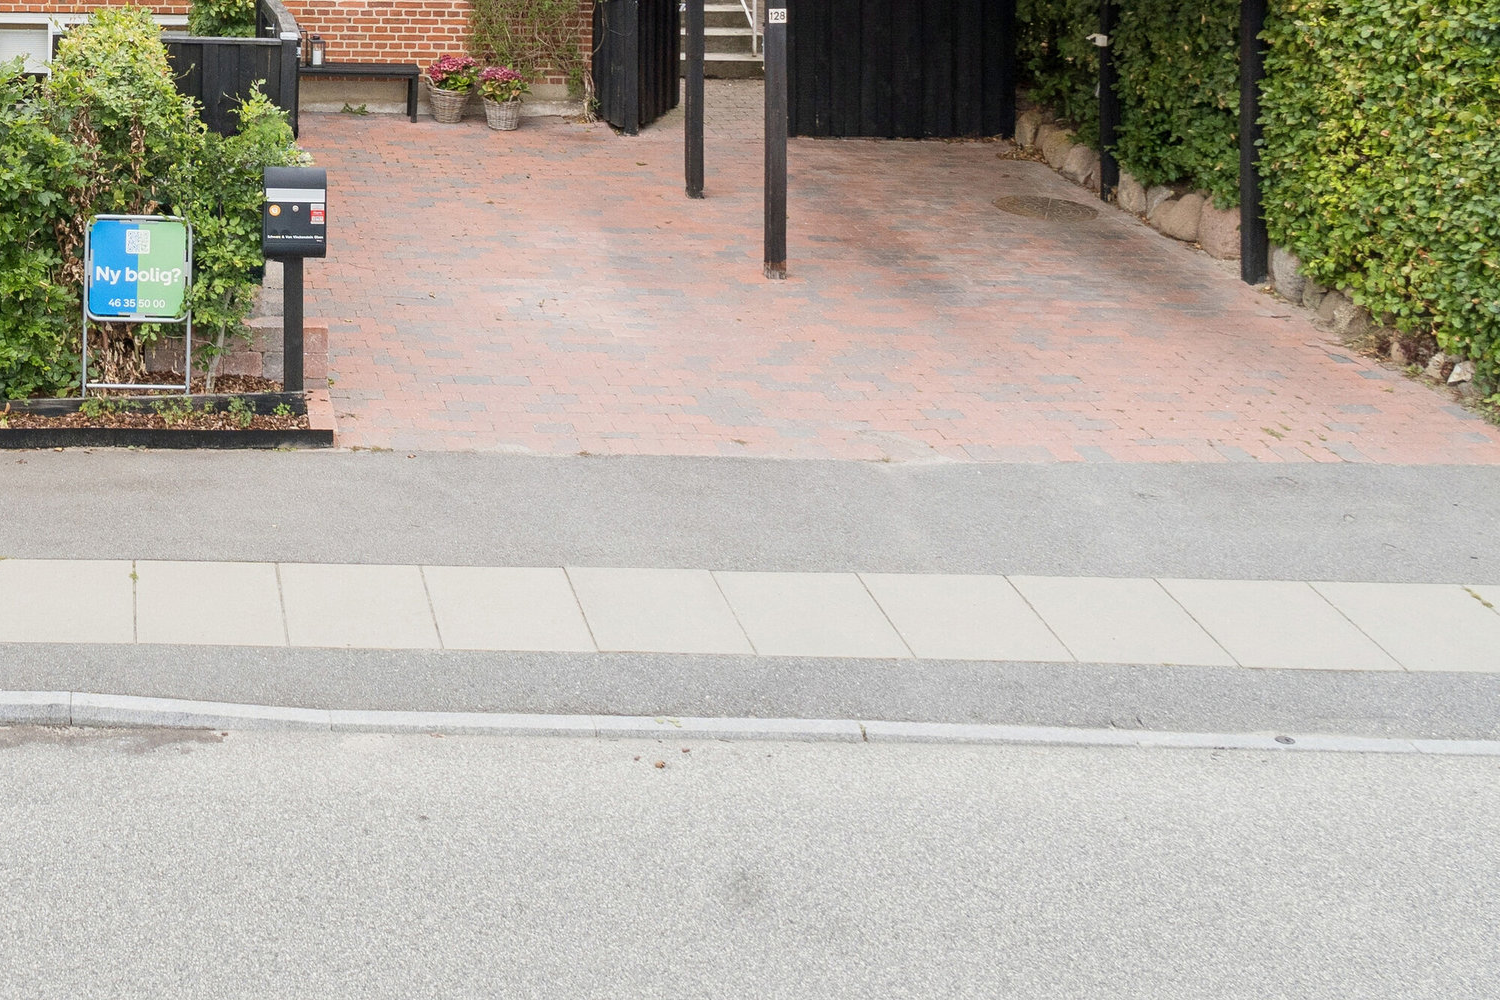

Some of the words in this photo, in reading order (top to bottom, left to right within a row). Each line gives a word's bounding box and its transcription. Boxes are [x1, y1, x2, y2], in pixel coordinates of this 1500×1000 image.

[770, 11, 786, 21] 128
[95, 266, 122, 285] Ny
[125, 266, 182, 286] bolig?
[108, 298, 122, 308] 46
[123, 298, 136, 308] 35
[138, 299, 151, 308] 50
[152, 299, 166, 308] 00
